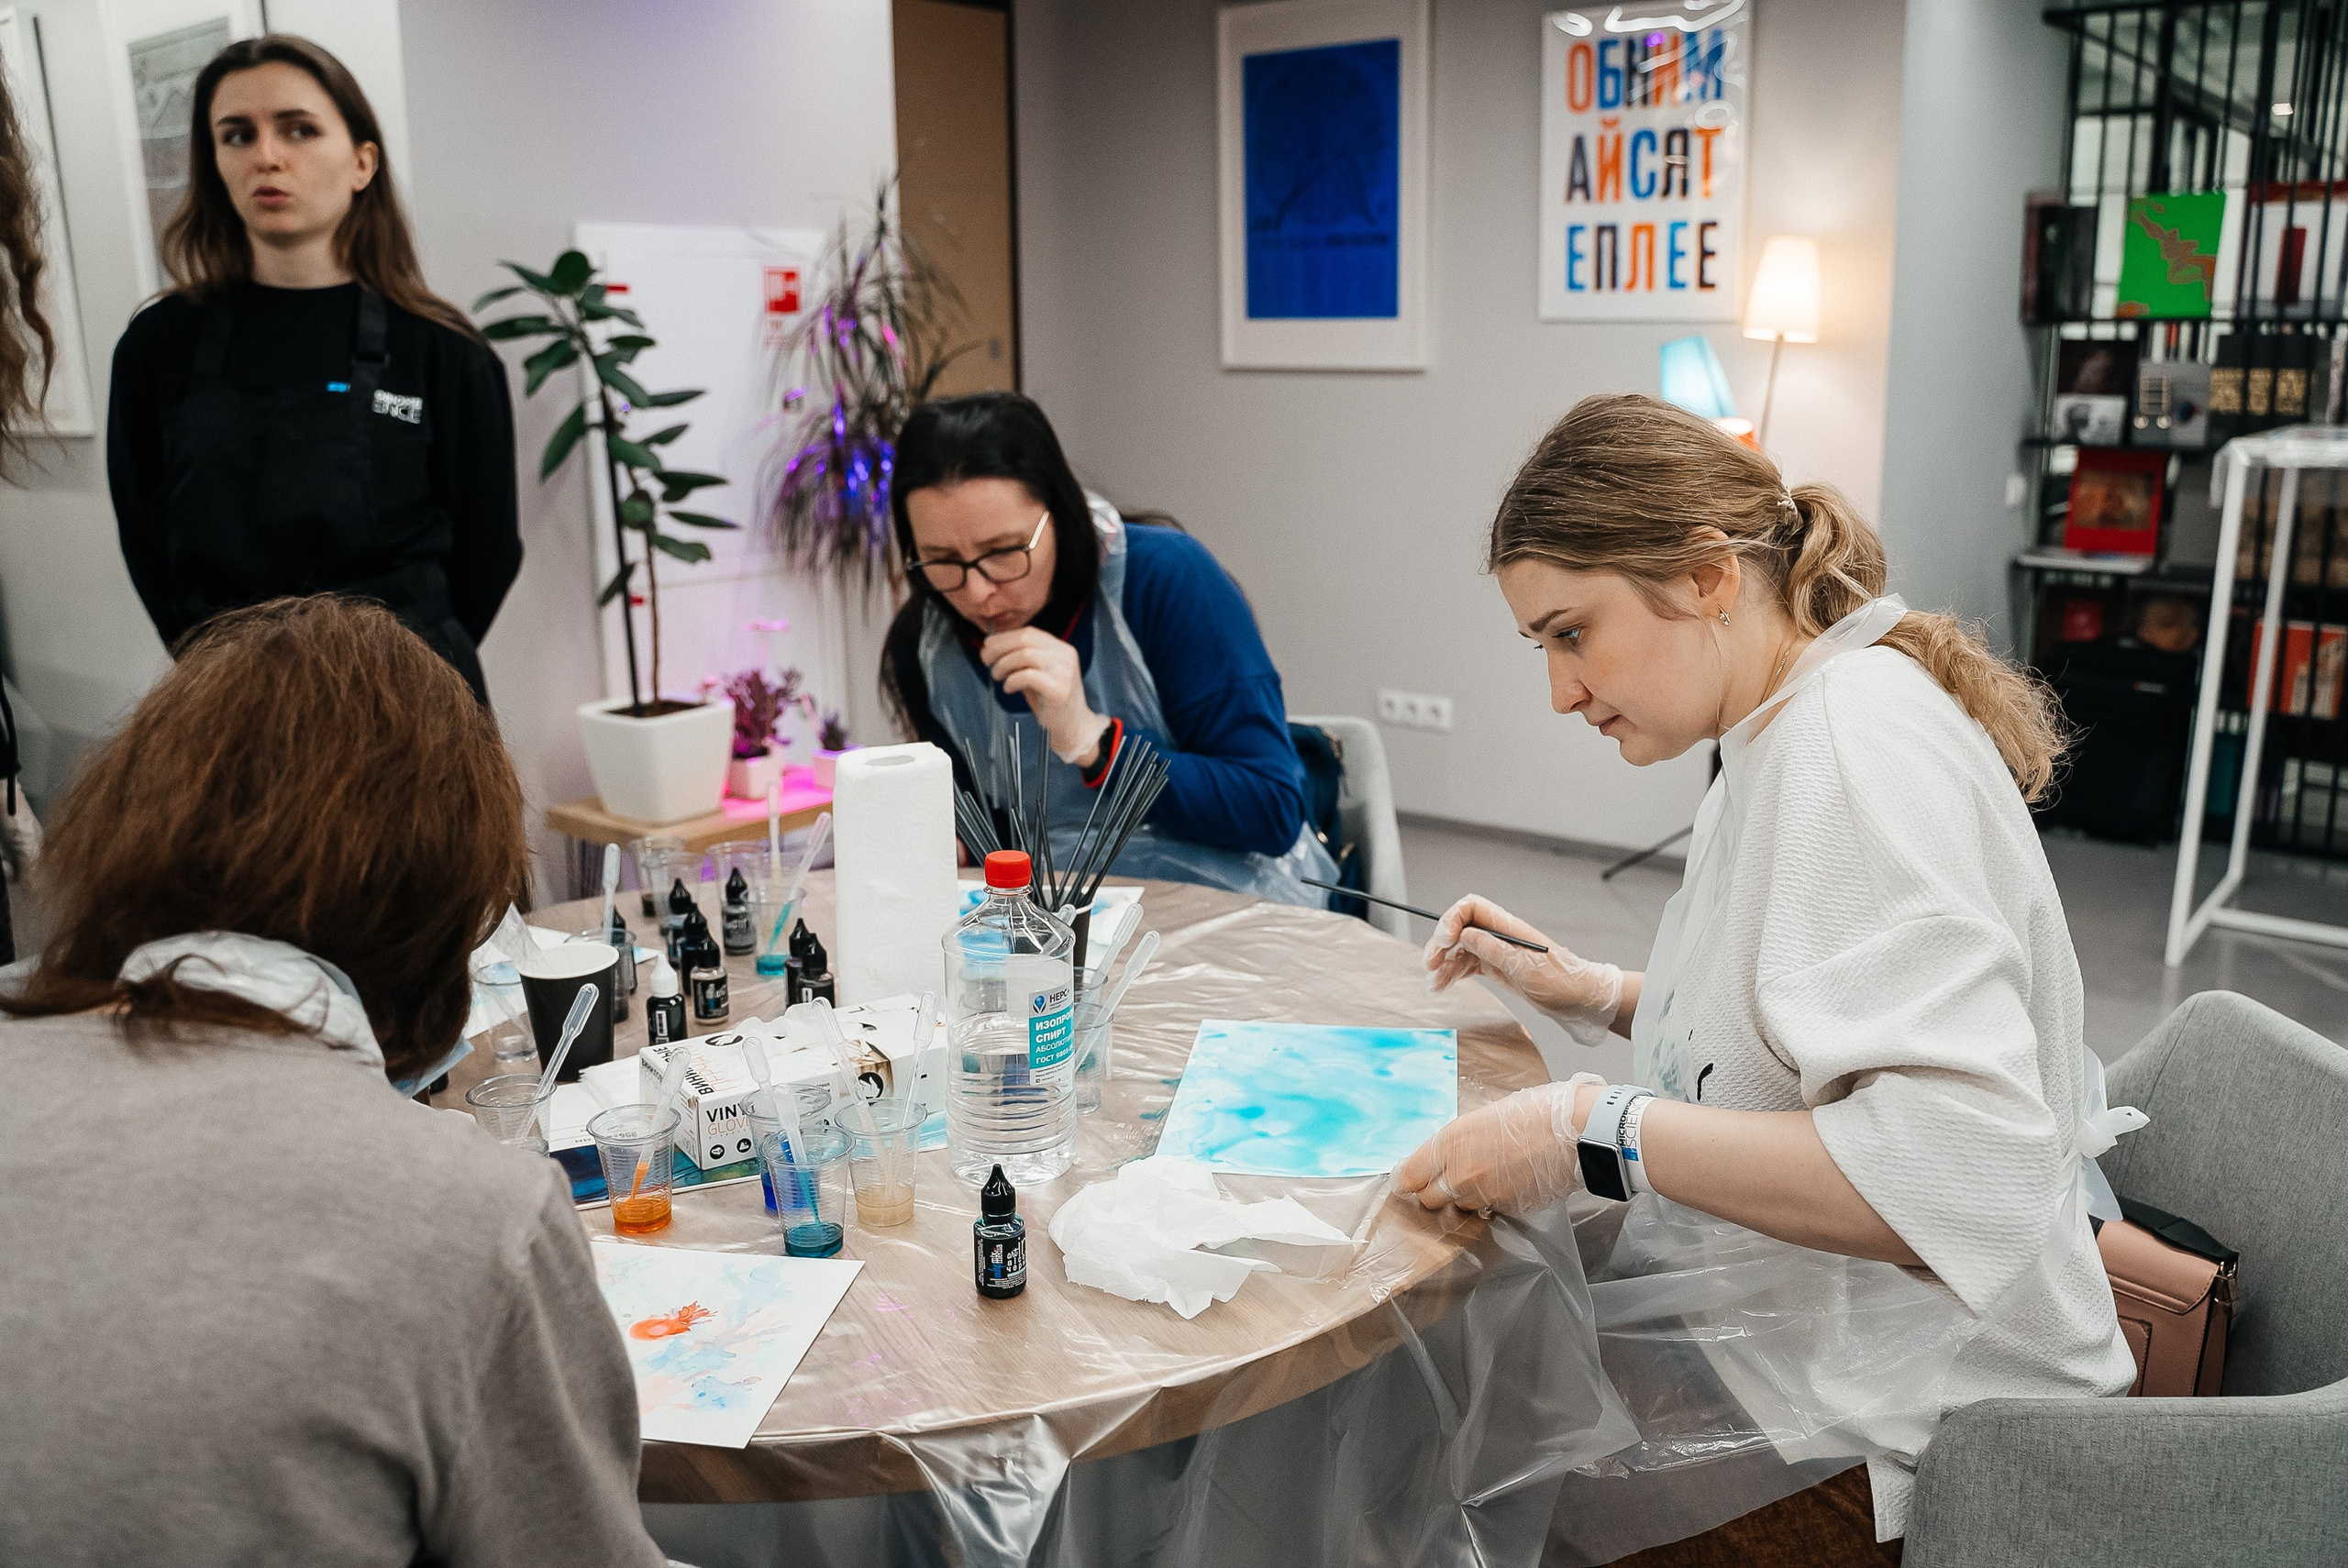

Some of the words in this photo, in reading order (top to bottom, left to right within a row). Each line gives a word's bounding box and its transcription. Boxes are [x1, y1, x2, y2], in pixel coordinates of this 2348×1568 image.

[1567, 28, 1725, 113] ОБНИМ
[1566, 116, 1723, 203] АЙСЯТ
[1566, 222, 1718, 293] ЕПЛЕЕ
[1036, 1026, 1067, 1043] СПИРТ
[1036, 1054, 1055, 1065] ГОСТ
